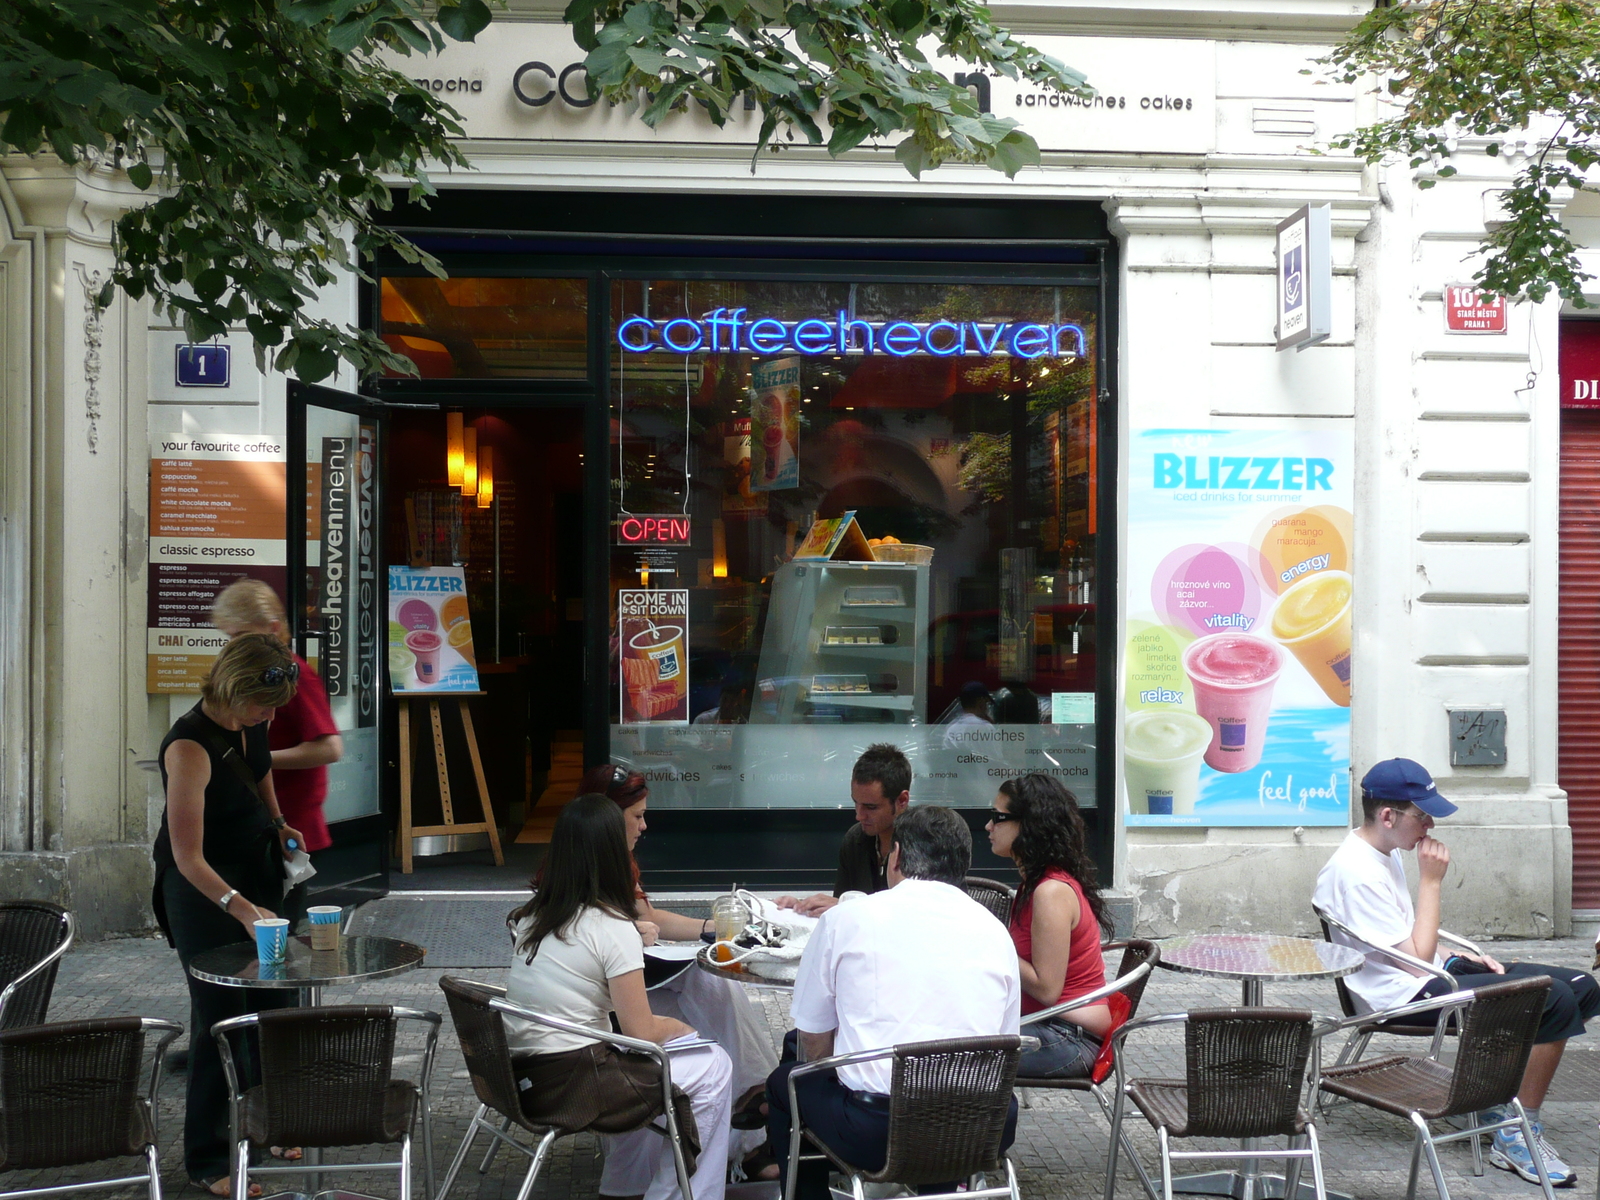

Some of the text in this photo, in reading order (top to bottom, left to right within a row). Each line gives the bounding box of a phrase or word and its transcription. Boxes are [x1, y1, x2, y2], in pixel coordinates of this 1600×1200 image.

[1140, 94, 1193, 111] cakes
[1457, 307, 1497, 318] STARÉ MĚSTO
[1464, 320, 1491, 328] PRAHA 1
[617, 307, 1087, 359] coffeeheaven
[198, 355, 206, 376] 1
[752, 366, 799, 389] BLIZZER
[1573, 379, 1600, 400] DI
[162, 440, 281, 453] your favourite coffee
[1153, 452, 1335, 491] BLIZZER
[1173, 491, 1302, 503] iced drinks for summer
[622, 518, 687, 541] OPEN
[1272, 519, 1306, 528] guarana
[1294, 529, 1324, 537] mango
[160, 544, 255, 558] classic espresso
[1280, 552, 1331, 583] energy
[388, 575, 463, 592] BLIZZER
[1171, 579, 1231, 589] hroznové víno
[187, 591, 215, 599] affogato
[622, 593, 667, 606] COME
[1176, 590, 1195, 598] acai
[622, 605, 686, 615] & SIT DOWN
[1203, 613, 1255, 631] vitality
[158, 635, 183, 647] CHAI
[1132, 634, 1160, 643] zelené
[1137, 644, 1164, 653] jablko
[1146, 653, 1177, 662] limetka
[1146, 662, 1177, 672] skořice
[1140, 686, 1184, 704] relax
[1217, 716, 1246, 724] coffee
[948, 729, 1025, 742] sandwiches
[1063, 747, 1086, 755] mocha
[957, 752, 989, 764] cakes
[711, 763, 732, 771] cakes
[1052, 765, 1089, 776] mocha
[935, 771, 958, 779] mocha
[1145, 788, 1174, 796] coffee
[1258, 770, 1341, 812] feel good
